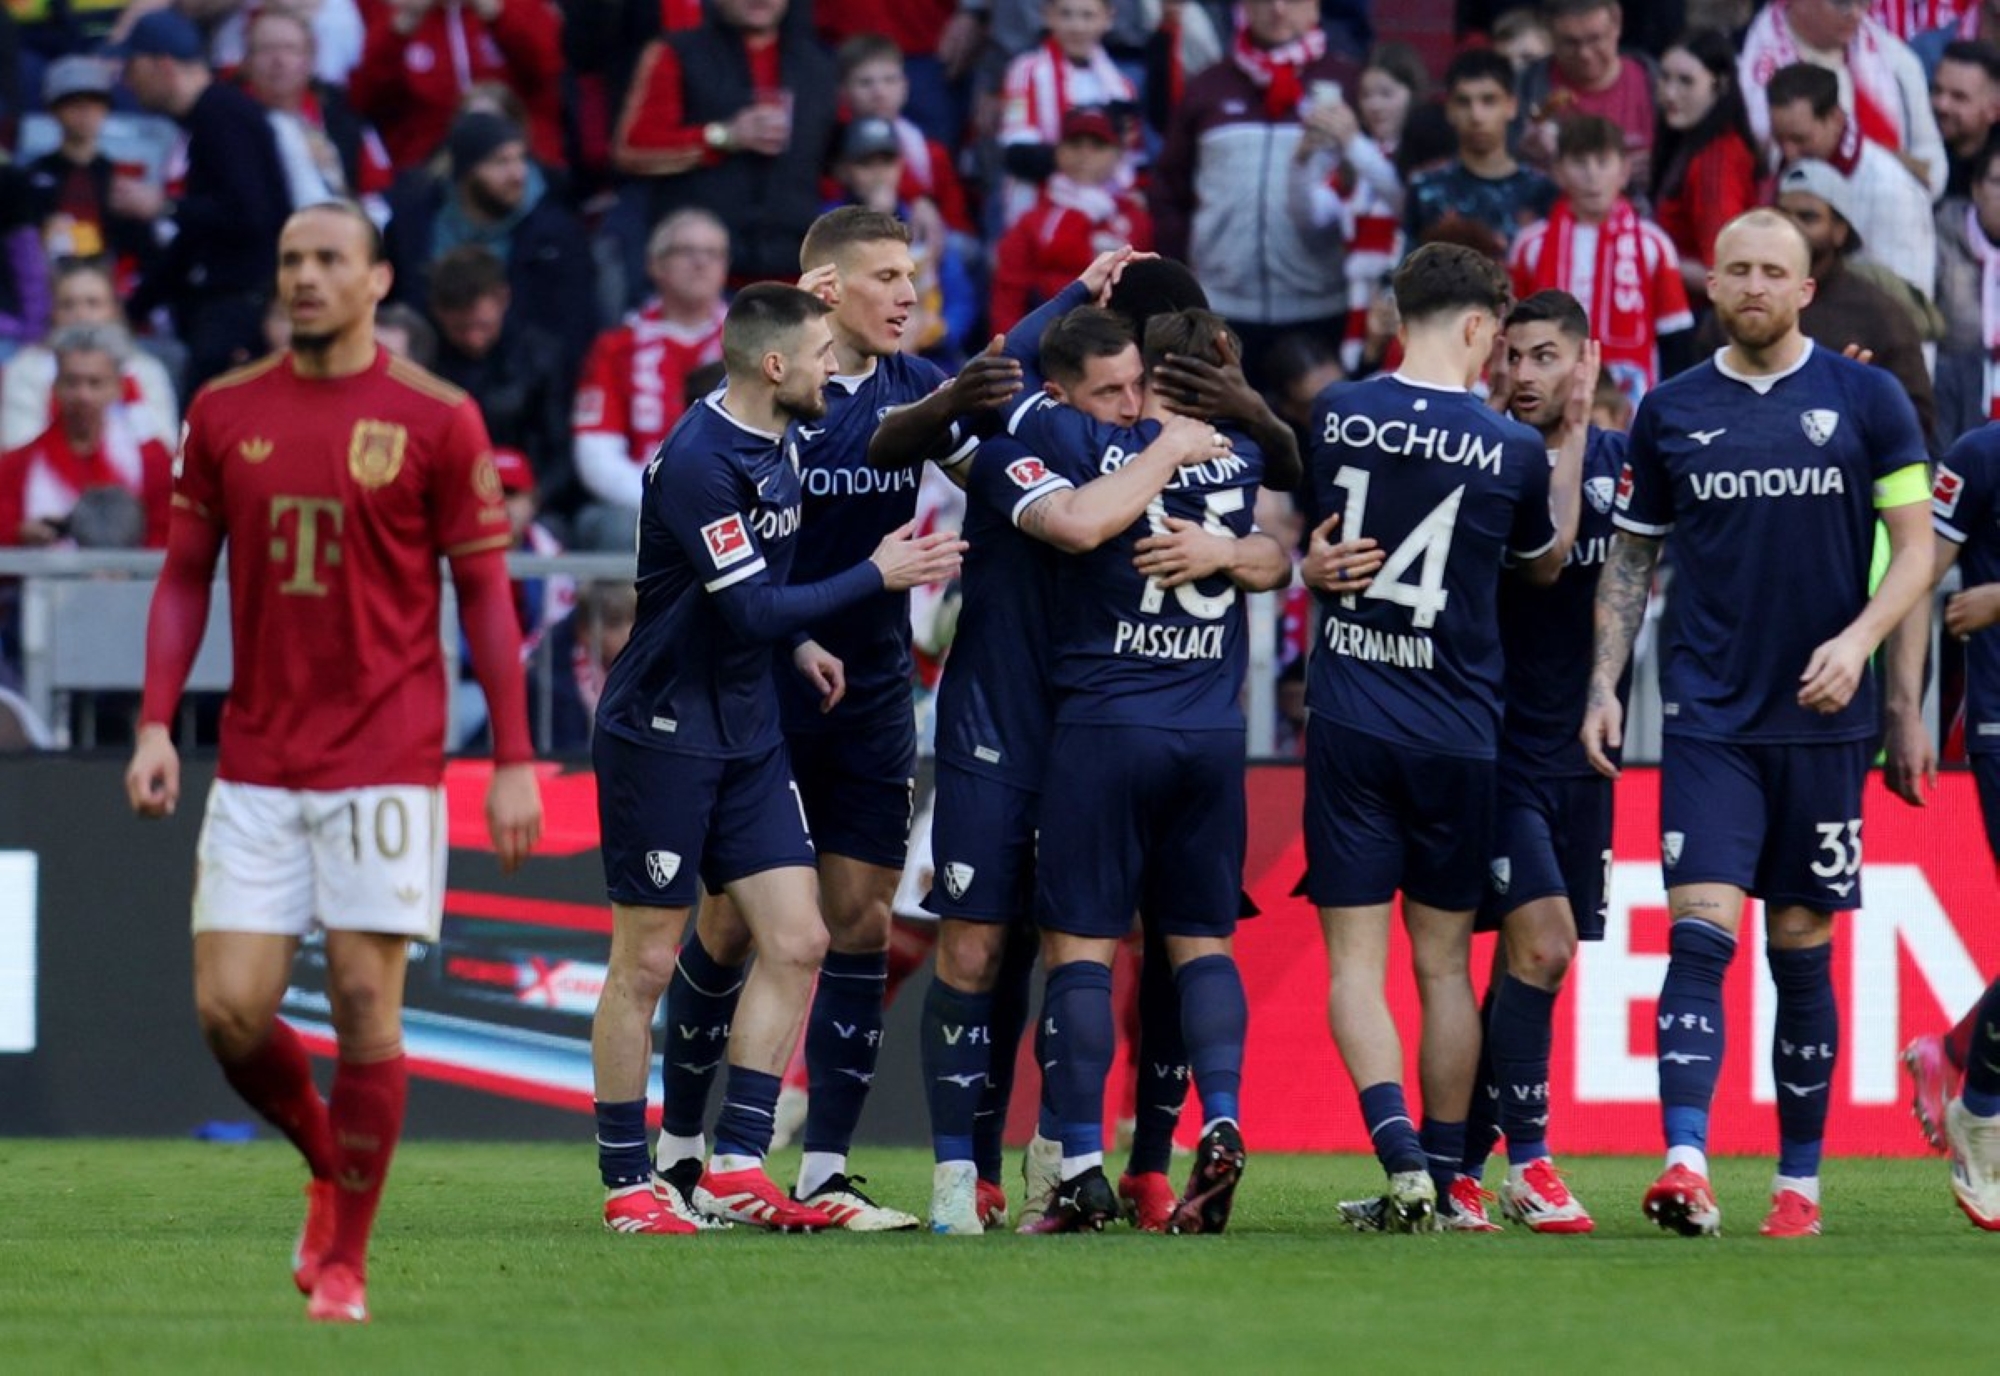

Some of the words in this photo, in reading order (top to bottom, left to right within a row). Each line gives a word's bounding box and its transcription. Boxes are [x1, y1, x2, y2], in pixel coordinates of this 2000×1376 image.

[1323, 411, 1503, 476] BOCHUM
[1689, 466, 1845, 500] VONOVIA
[1334, 464, 1466, 629] 14
[1113, 619, 1226, 660] PASSLACK
[345, 796, 410, 865] 10
[1810, 819, 1862, 878] 33
[942, 1024, 991, 1045] VfL
[1658, 1013, 1714, 1034] VfL
[1780, 1039, 1834, 1060] VfL
